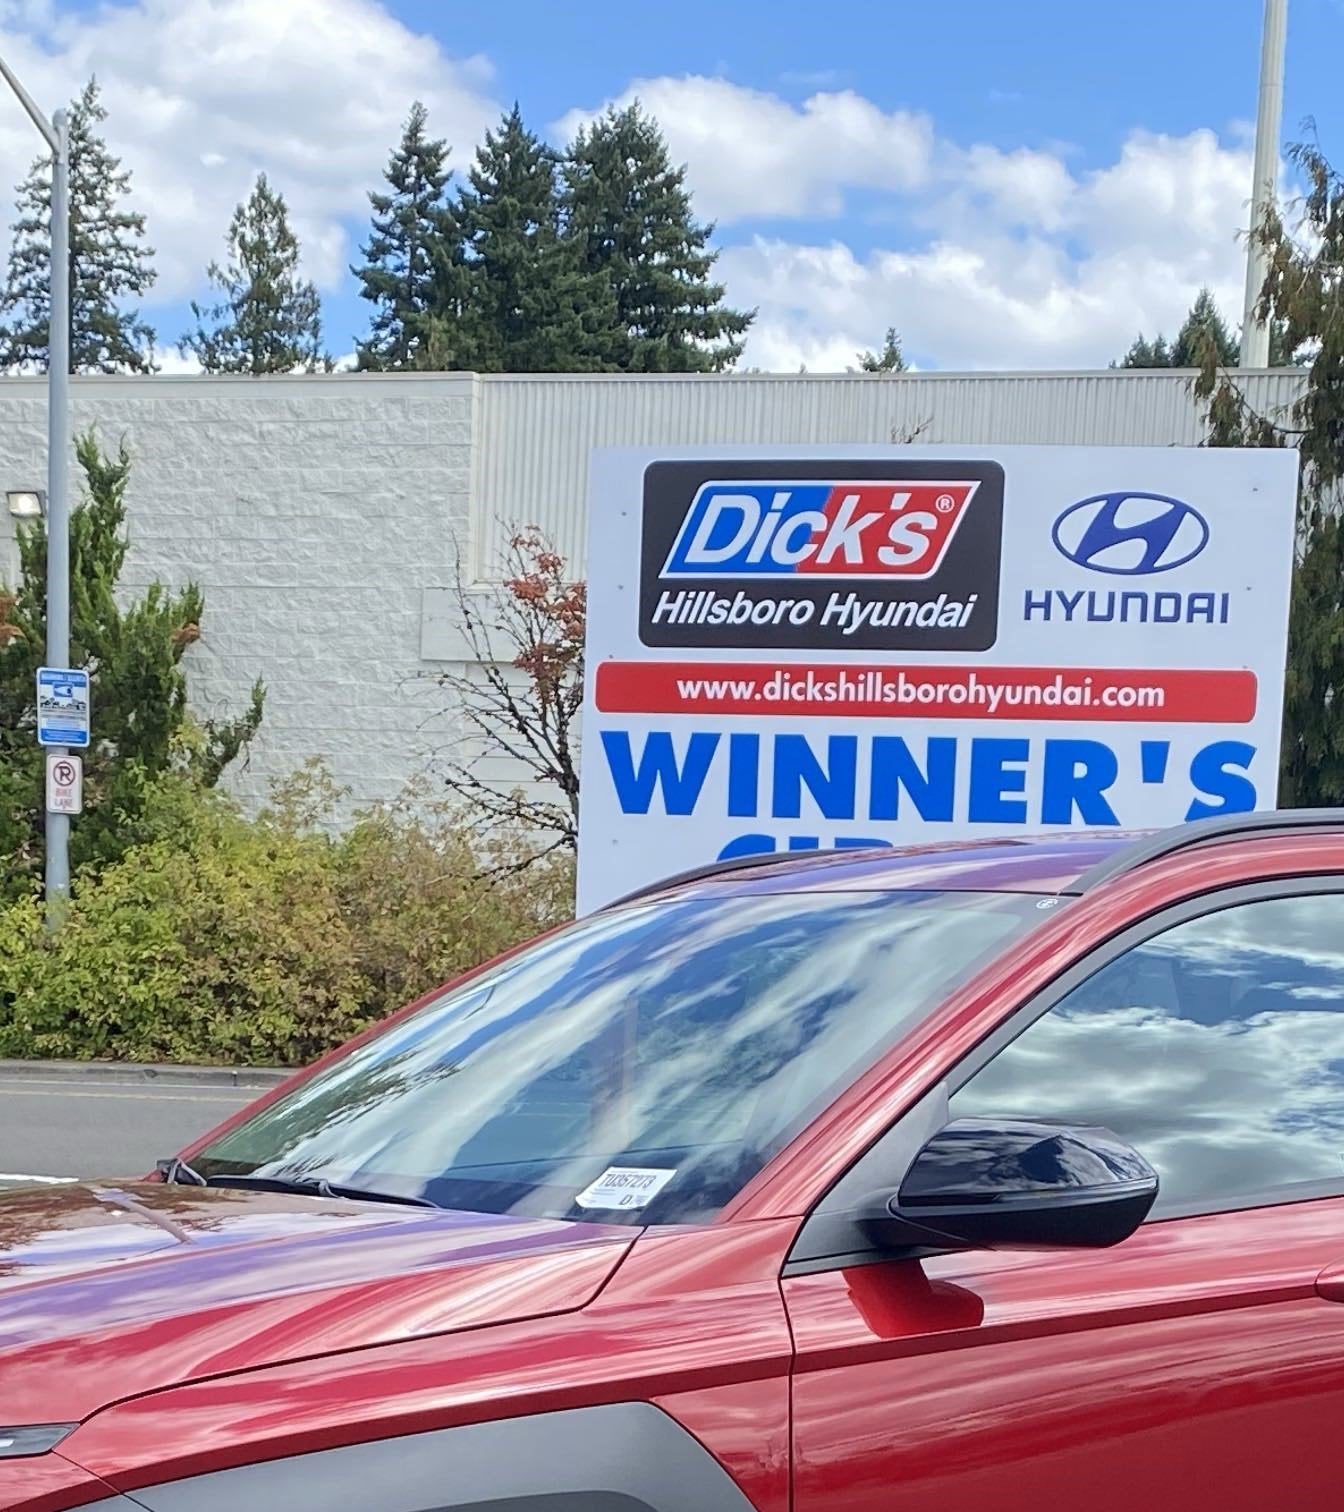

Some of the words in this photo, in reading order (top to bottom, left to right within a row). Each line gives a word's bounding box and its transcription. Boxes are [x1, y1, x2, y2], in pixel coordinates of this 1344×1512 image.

[652, 591, 814, 625] Hillsboro
[820, 593, 978, 635] Hyundai
[1023, 589, 1230, 624] HYUNDAI
[677, 672, 1164, 712] www.dickshillsborohyundai.com
[600, 730, 1257, 825] WINNER'S
